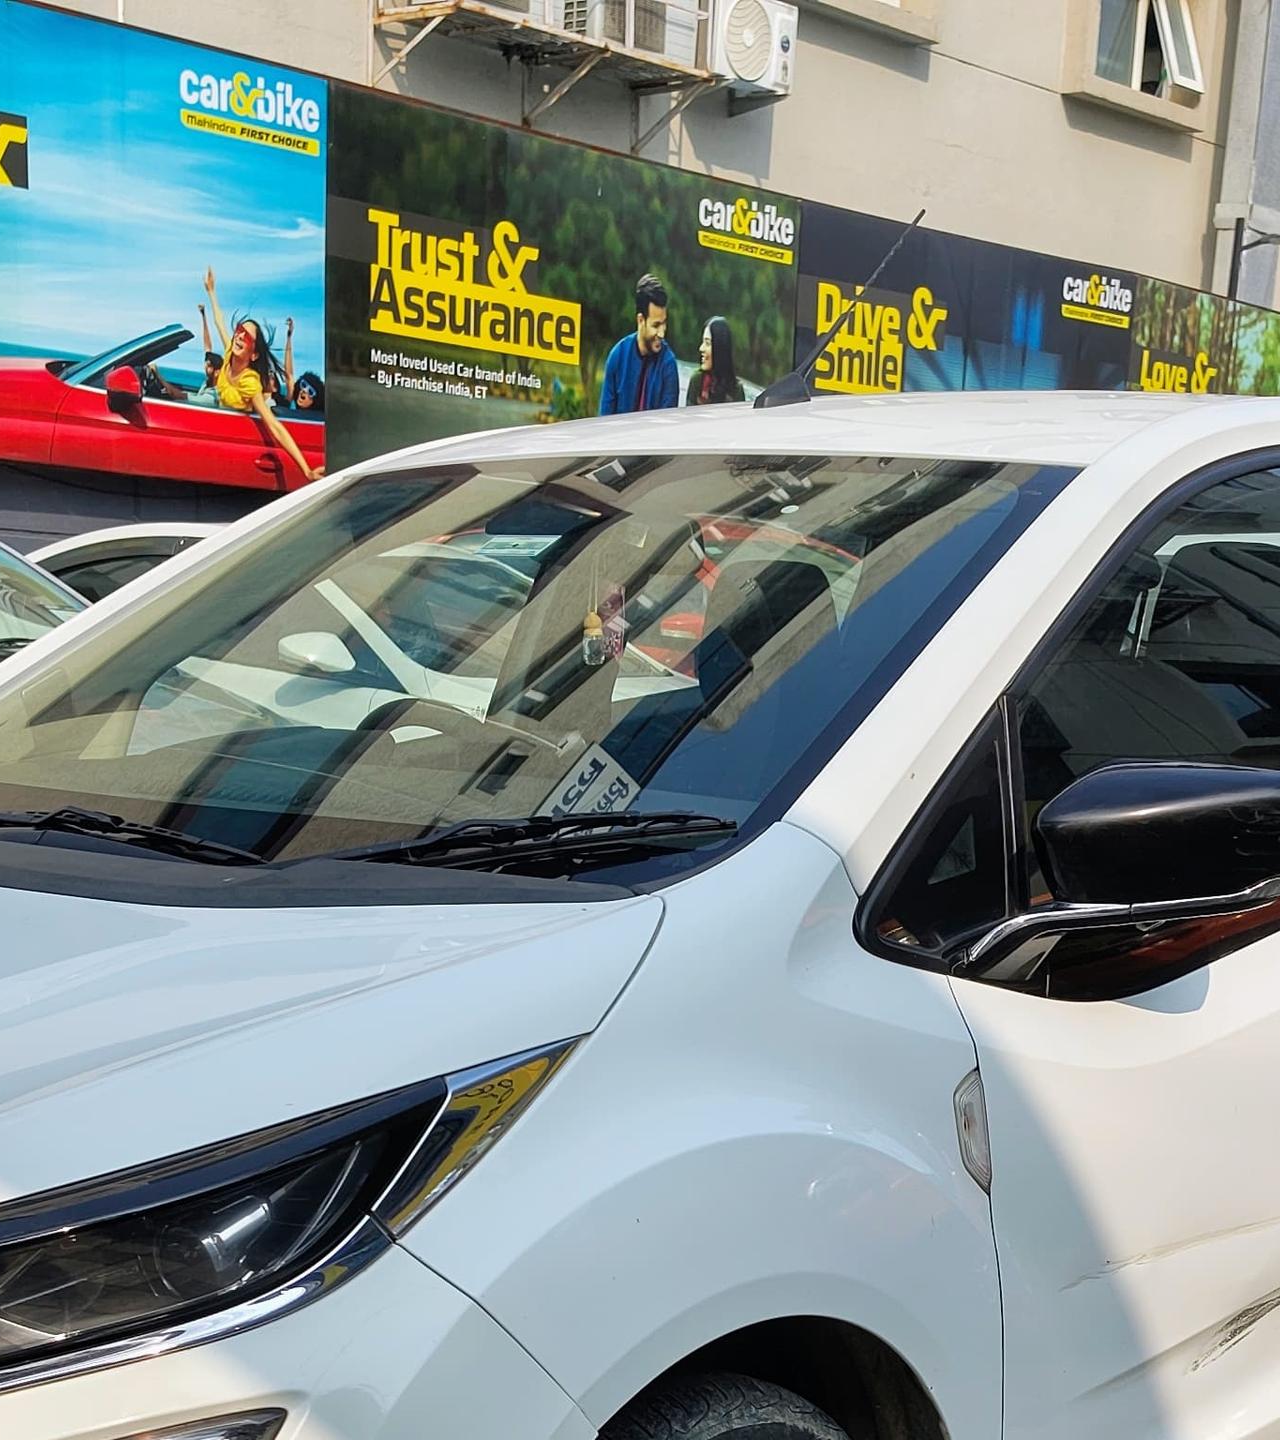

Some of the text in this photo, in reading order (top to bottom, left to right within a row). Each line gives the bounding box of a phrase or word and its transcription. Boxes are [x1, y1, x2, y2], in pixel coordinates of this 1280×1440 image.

[180, 70, 320, 132] car&bike
[240, 127, 270, 142] FIRST
[272, 134, 308, 151] CHOICE
[699, 198, 795, 245] car&bike
[368, 208, 540, 294] Trust &
[371, 267, 576, 354] Assurance
[1063, 274, 1132, 312] car&bike
[817, 282, 948, 351] Drive &
[370, 348, 542, 389] Most loved Used Car brand of India
[377, 370, 393, 388] By
[394, 372, 444, 393] Franchise
[445, 381, 473, 399] India,
[474, 385, 489, 400] ET
[1141, 349, 1218, 394] Love &
